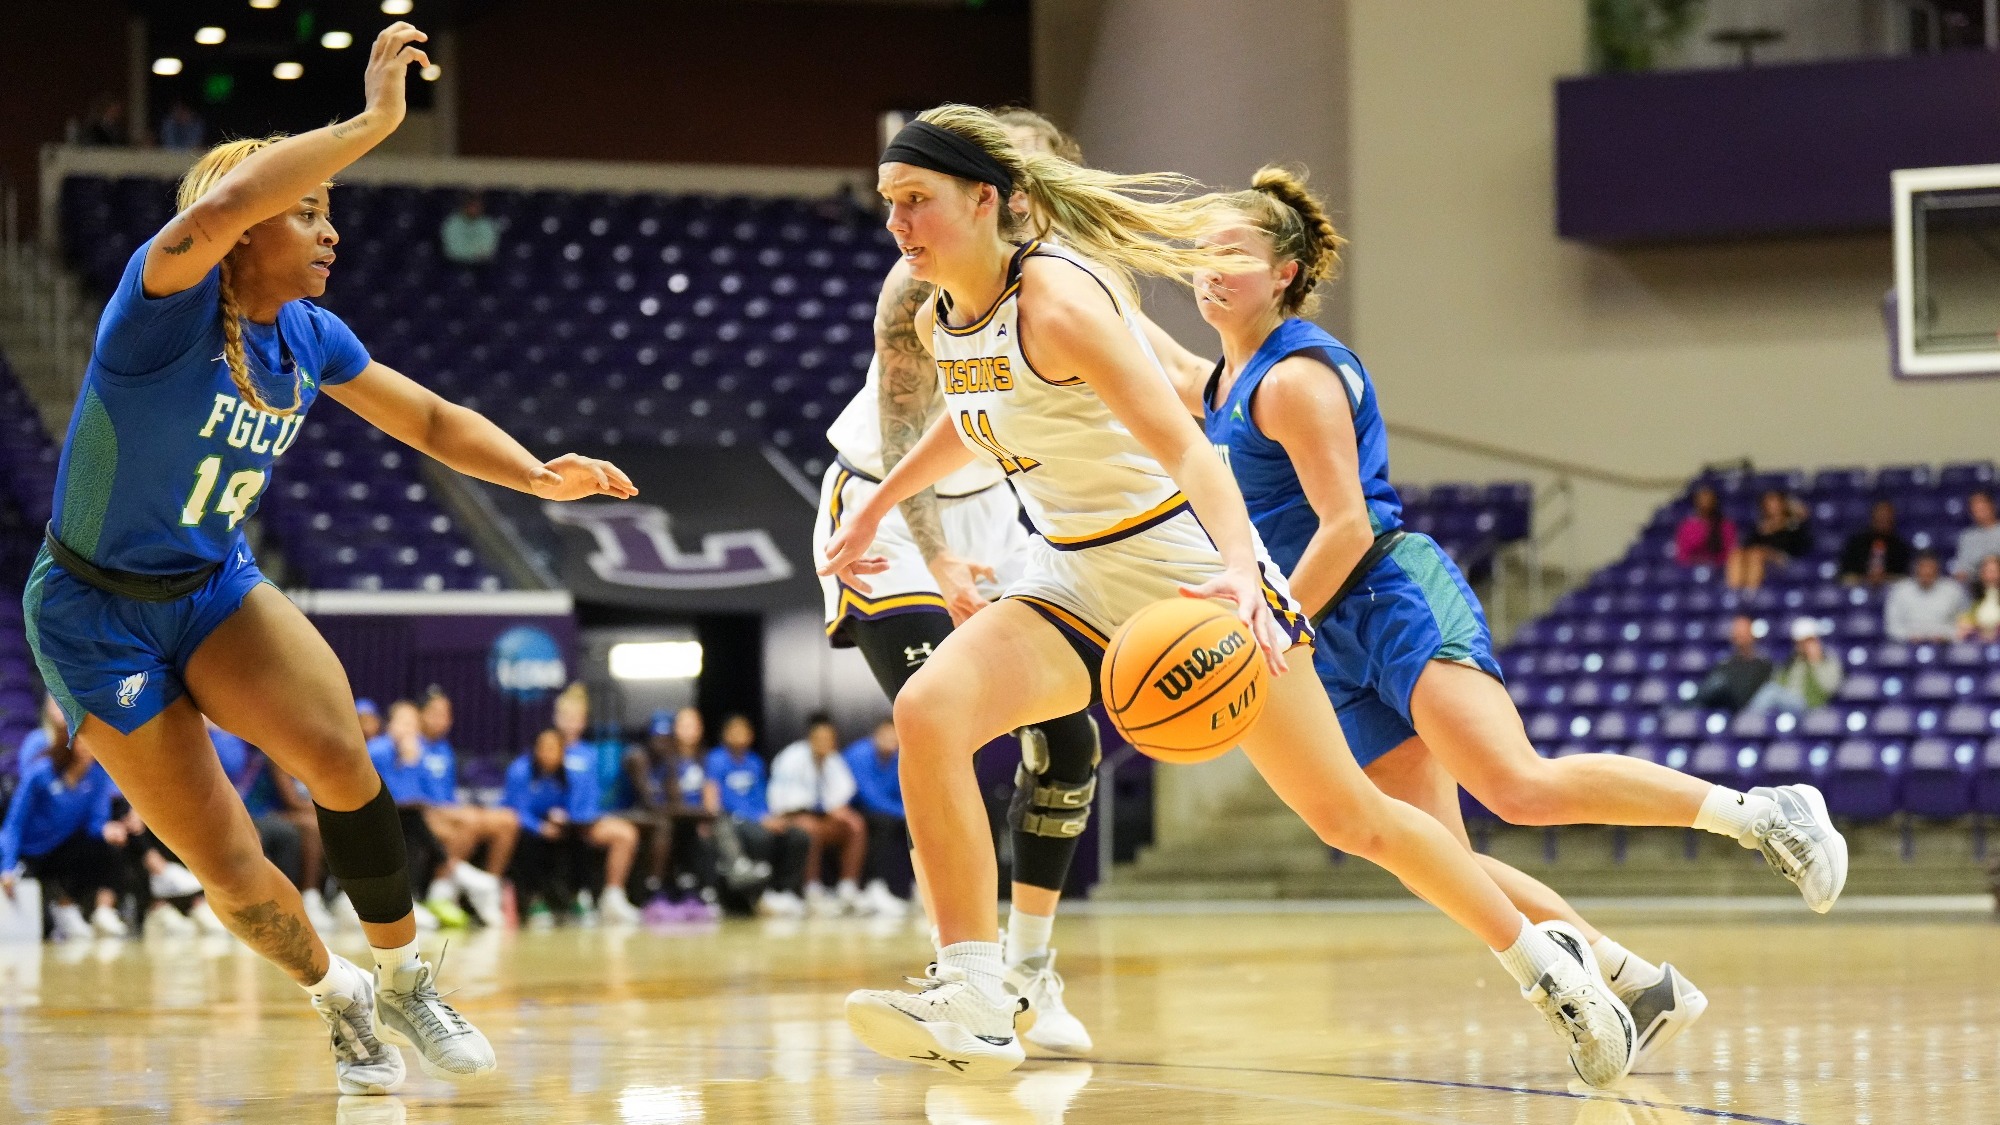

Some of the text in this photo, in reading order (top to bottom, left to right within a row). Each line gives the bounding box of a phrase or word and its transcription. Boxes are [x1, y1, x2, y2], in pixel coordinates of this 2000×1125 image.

[937, 355, 1014, 394] ISONS
[199, 392, 305, 456] FGCU
[960, 409, 1043, 477] 11
[178, 453, 267, 533] 14
[543, 501, 795, 590] L
[1153, 630, 1247, 701] Wilson
